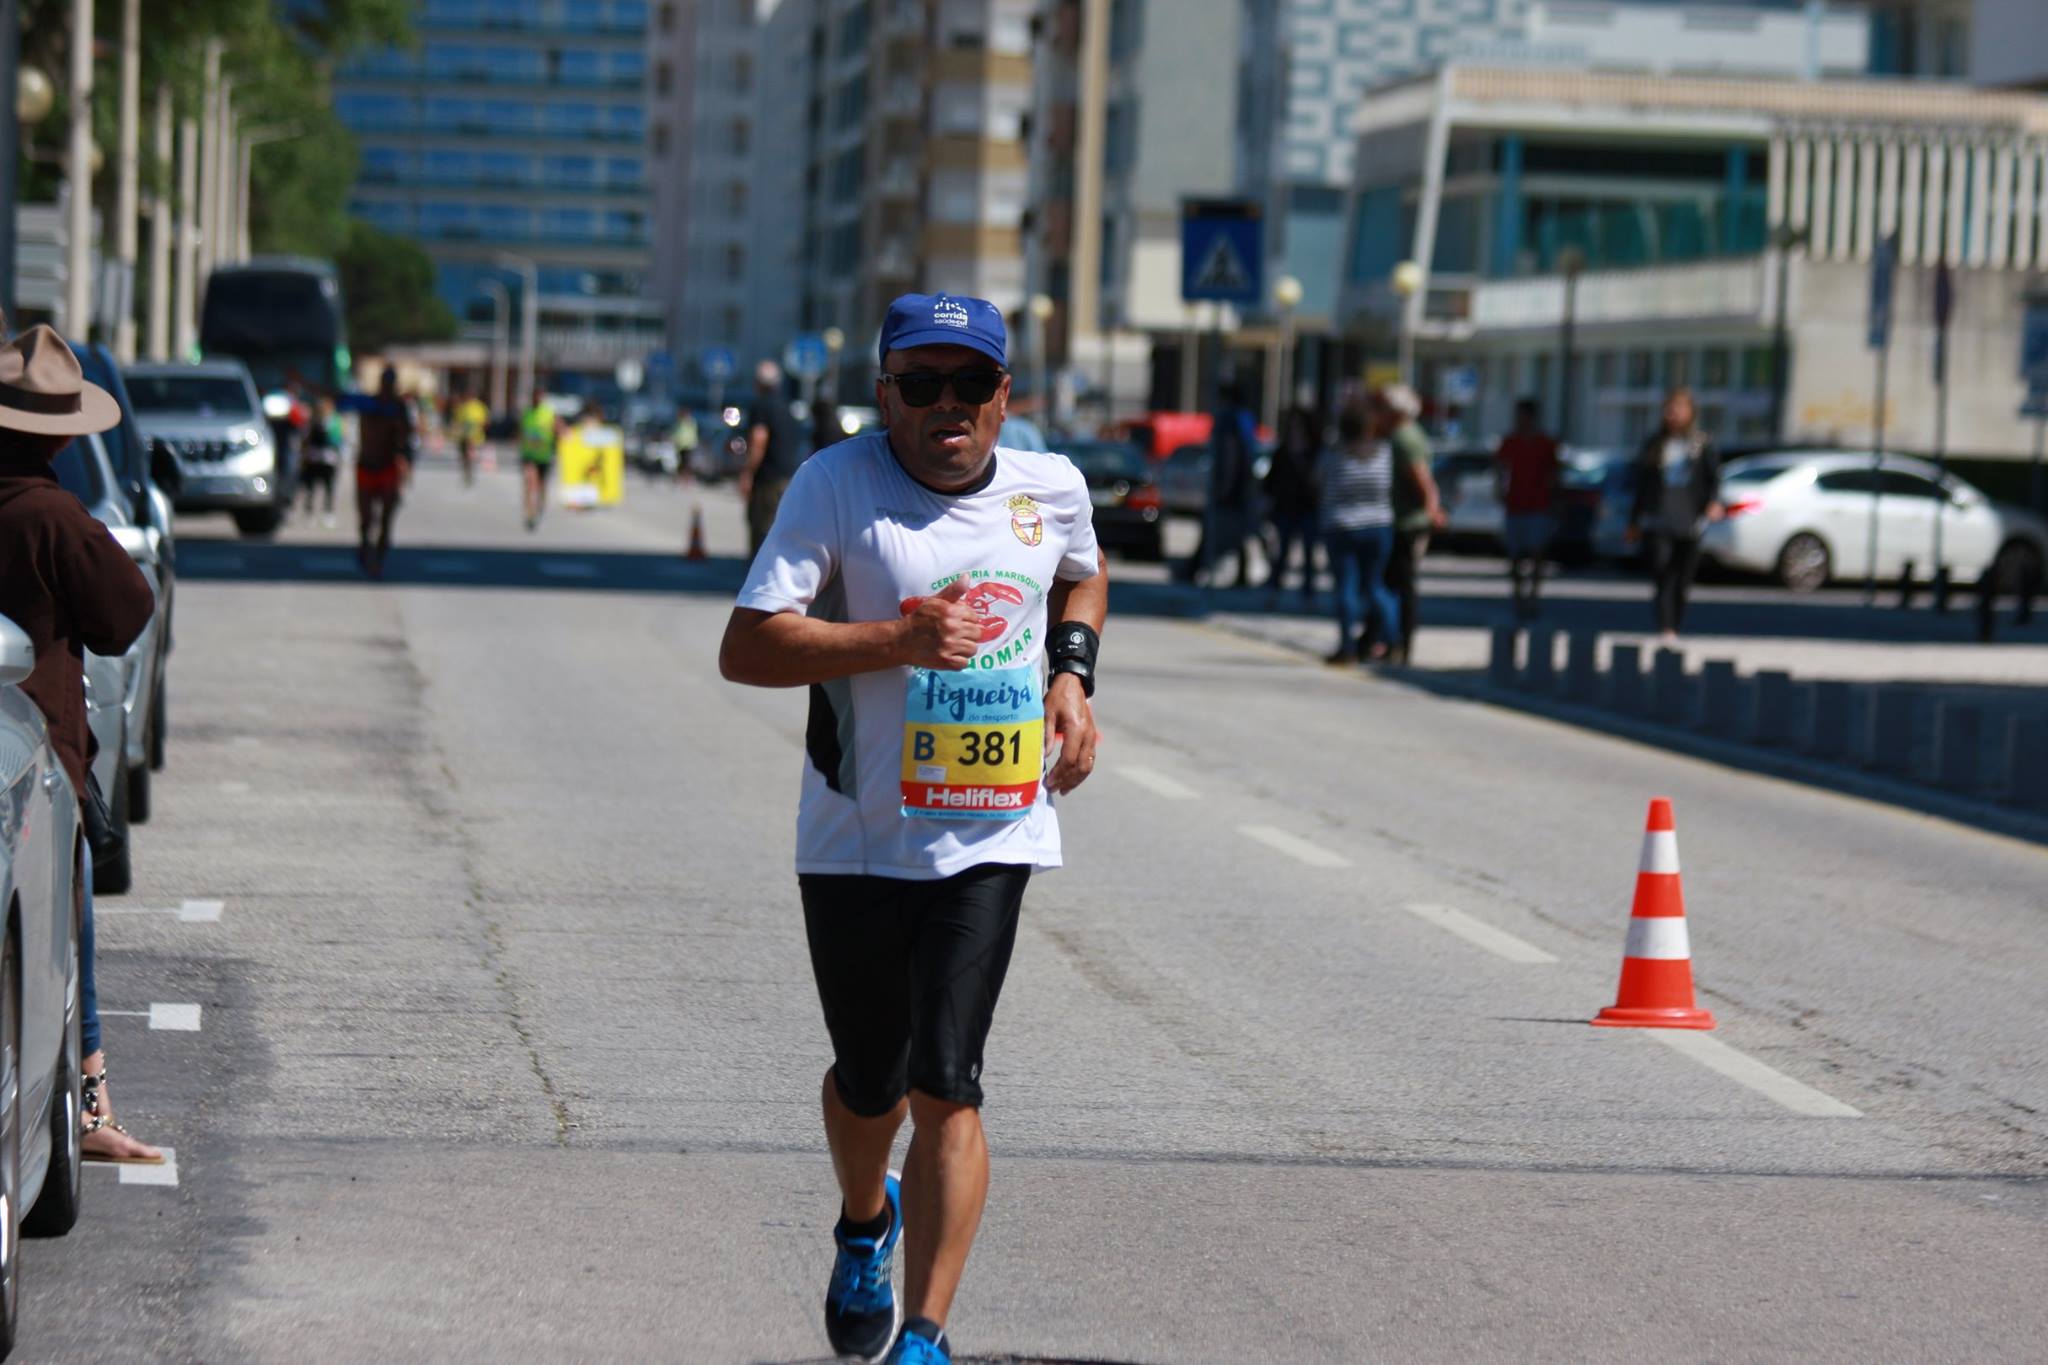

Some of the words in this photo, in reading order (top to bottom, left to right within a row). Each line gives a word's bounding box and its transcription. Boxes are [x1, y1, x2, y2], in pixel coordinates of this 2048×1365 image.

[934, 312, 968, 320] corrida
[931, 570, 989, 590] CERVERIA
[914, 731, 935, 761] B
[958, 730, 1020, 766] 381
[926, 787, 1023, 807] Heliflex
